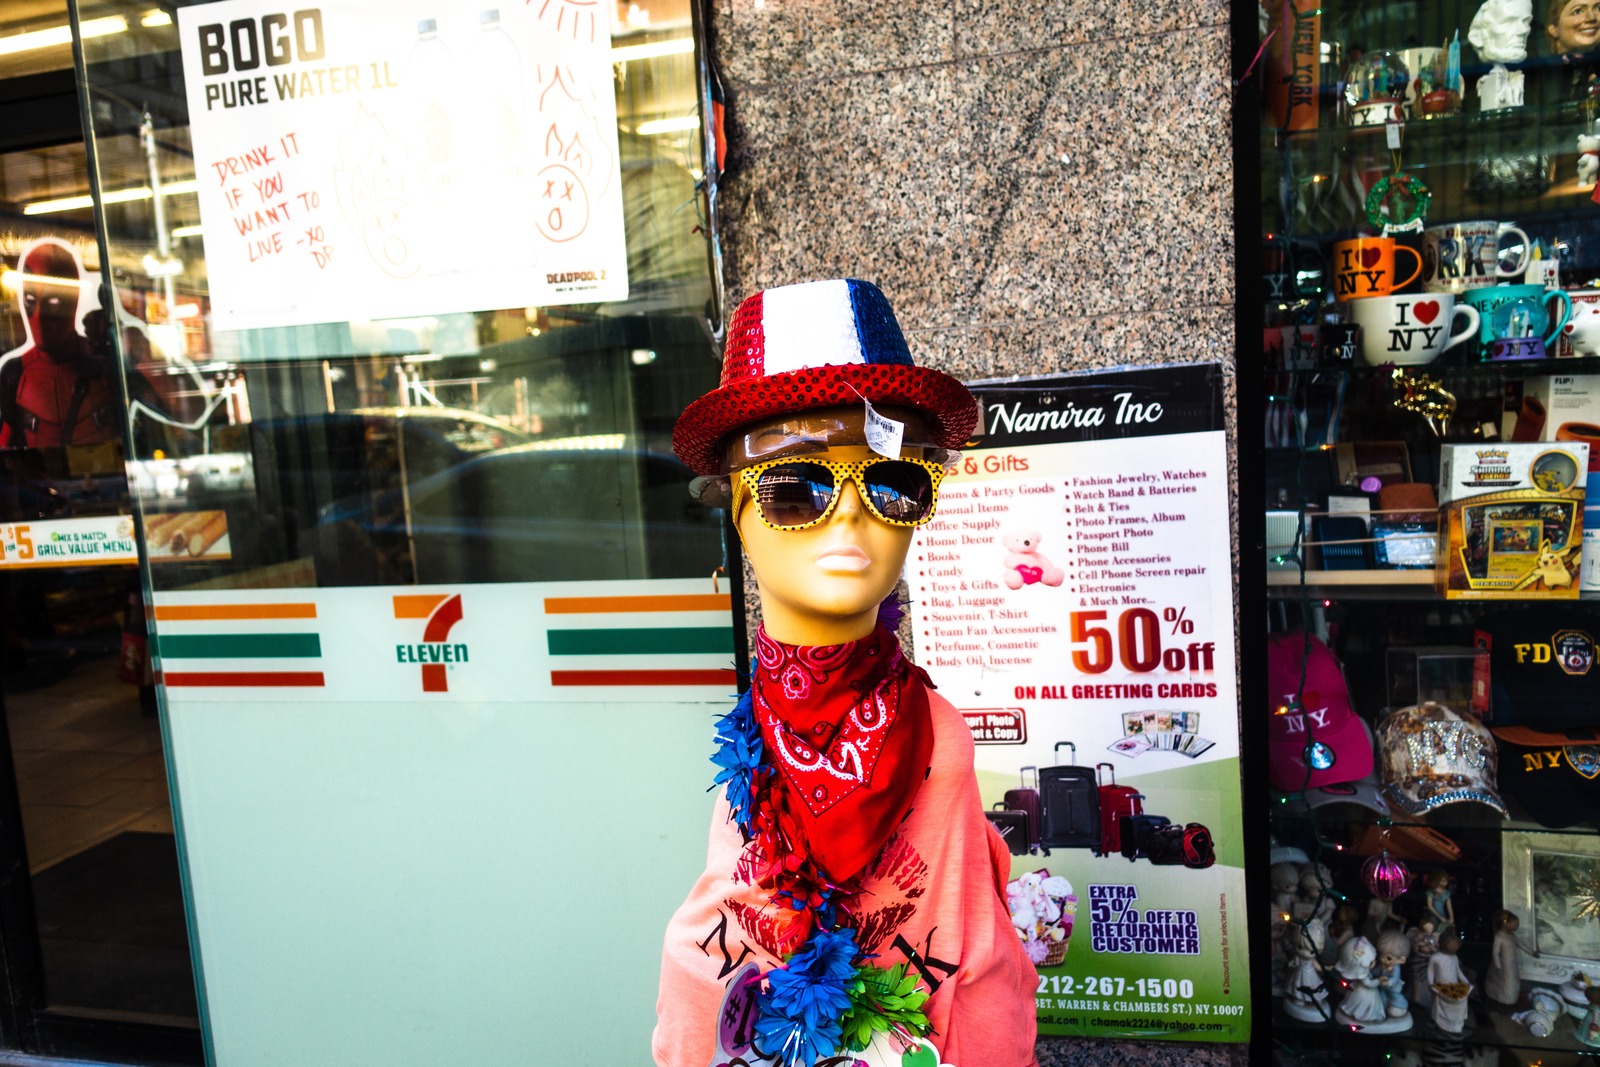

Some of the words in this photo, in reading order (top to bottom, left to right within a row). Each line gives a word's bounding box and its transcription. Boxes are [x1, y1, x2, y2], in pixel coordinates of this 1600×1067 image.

[198, 8, 325, 76] BOGO
[1296, 21, 1314, 56] NEW
[205, 77, 269, 110] PURE
[274, 65, 362, 101] WATER
[370, 61, 398, 89] 1L
[1294, 64, 1313, 107] YORK
[211, 145, 275, 186] DRINK
[280, 132, 299, 158] IT
[225, 188, 243, 210] IF
[253, 171, 283, 203] YOU
[234, 202, 290, 236] WANT
[297, 191, 319, 211] TO
[248, 232, 283, 262] LIVE
[1341, 249, 1353, 271] I
[547, 271, 598, 284] DEADPOOL
[1338, 271, 1386, 295] NY
[1395, 303, 1410, 326] I
[1387, 326, 1443, 352] NY
[1506, 341, 1540, 357] NY
[988, 402, 1106, 435] Namira
[1114, 392, 1163, 425] Inc
[964, 457, 978, 475] &
[984, 454, 1029, 474] Gifts
[1072, 476, 1113, 487] Fashion
[1116, 472, 1160, 485] Jewelry,
[1162, 469, 1207, 481] Watches
[972, 488, 980, 498] &
[984, 486, 1015, 498] Party
[1019, 483, 1055, 495] Goods
[1073, 489, 1105, 500] Watch
[1108, 487, 1134, 498] Band
[1137, 487, 1145, 496] &
[1149, 483, 1197, 496] Batteries
[936, 503, 974, 516] asonal
[977, 503, 1009, 513] Items
[1074, 503, 1094, 513] Belt
[1097, 503, 1105, 512] &
[1108, 502, 1130, 511] Ties
[925, 520, 958, 532] Office
[962, 517, 1001, 531] Supply
[1075, 516, 1105, 527] Photo
[1108, 515, 1149, 525] Frames,
[1151, 512, 1186, 523] Album
[82, 531, 107, 541] MATCH
[926, 536, 957, 547] Home
[962, 535, 994, 545] Decor
[1076, 529, 1120, 541] Passport
[1123, 528, 1154, 538] Photo
[37, 544, 66, 556] GRILL
[68, 542, 100, 554] VALUE
[103, 540, 132, 553] MENU
[1077, 544, 1108, 554] Phone
[1111, 542, 1129, 552] Bill
[927, 552, 961, 562] Books
[1078, 557, 1109, 567] Phone
[1112, 553, 1172, 566] Accessories
[928, 567, 963, 578] Candy
[1078, 570, 1098, 580] Cell
[1101, 569, 1132, 579] Phone
[1135, 568, 1171, 577] Screen
[1173, 565, 1207, 577] repair
[930, 582, 956, 593] Toys
[959, 581, 968, 591] &
[971, 579, 999, 590] Gifts
[1079, 582, 1136, 594] Electronics
[931, 597, 955, 608] Bag,
[958, 596, 1005, 607] Luggage
[1079, 598, 1087, 606] &
[1090, 597, 1118, 606] Much
[987, 609, 1029, 619] T-Shirt
[932, 627, 963, 637] Team
[966, 625, 987, 636] Fan
[991, 622, 1057, 635] Accessories
[392, 593, 463, 692] 7
[987, 638, 1040, 650] Cosmetic
[936, 656, 962, 667] Body
[989, 654, 1032, 665] Incense
[1162, 642, 1215, 671] off
[1514, 643, 1551, 663] FD
[1014, 685, 1036, 700] ON
[1041, 685, 1067, 699] ALL
[1072, 684, 1153, 699] GREETING
[1158, 683, 1217, 698] CARDS
[986, 715, 1015, 726] Photo
[1284, 707, 1331, 733] NY
[985, 729, 993, 739] &
[994, 727, 1018, 740] Copy
[1407, 721, 1486, 771] NYC
[1523, 751, 1562, 772] NY
[1090, 886, 1136, 899] EXTRA
[1091, 898, 1139, 924] 5%
[1146, 911, 1172, 924] OFF
[1175, 911, 1195, 924] TO
[1092, 923, 1198, 939] RETURNING
[1093, 937, 1199, 954] CUSTOMER
[1037, 975, 1194, 999] 212-267-1500
[1058, 1000, 1100, 1011] WARREN
[1103, 1001, 1110, 1011] &
[1113, 1001, 1170, 1014] CHAMBERS
[1196, 1004, 1210, 1014] NY
[1213, 1004, 1244, 1016] 10007
[1090, 1018, 1223, 1031] chamak2224@yahoo.com
